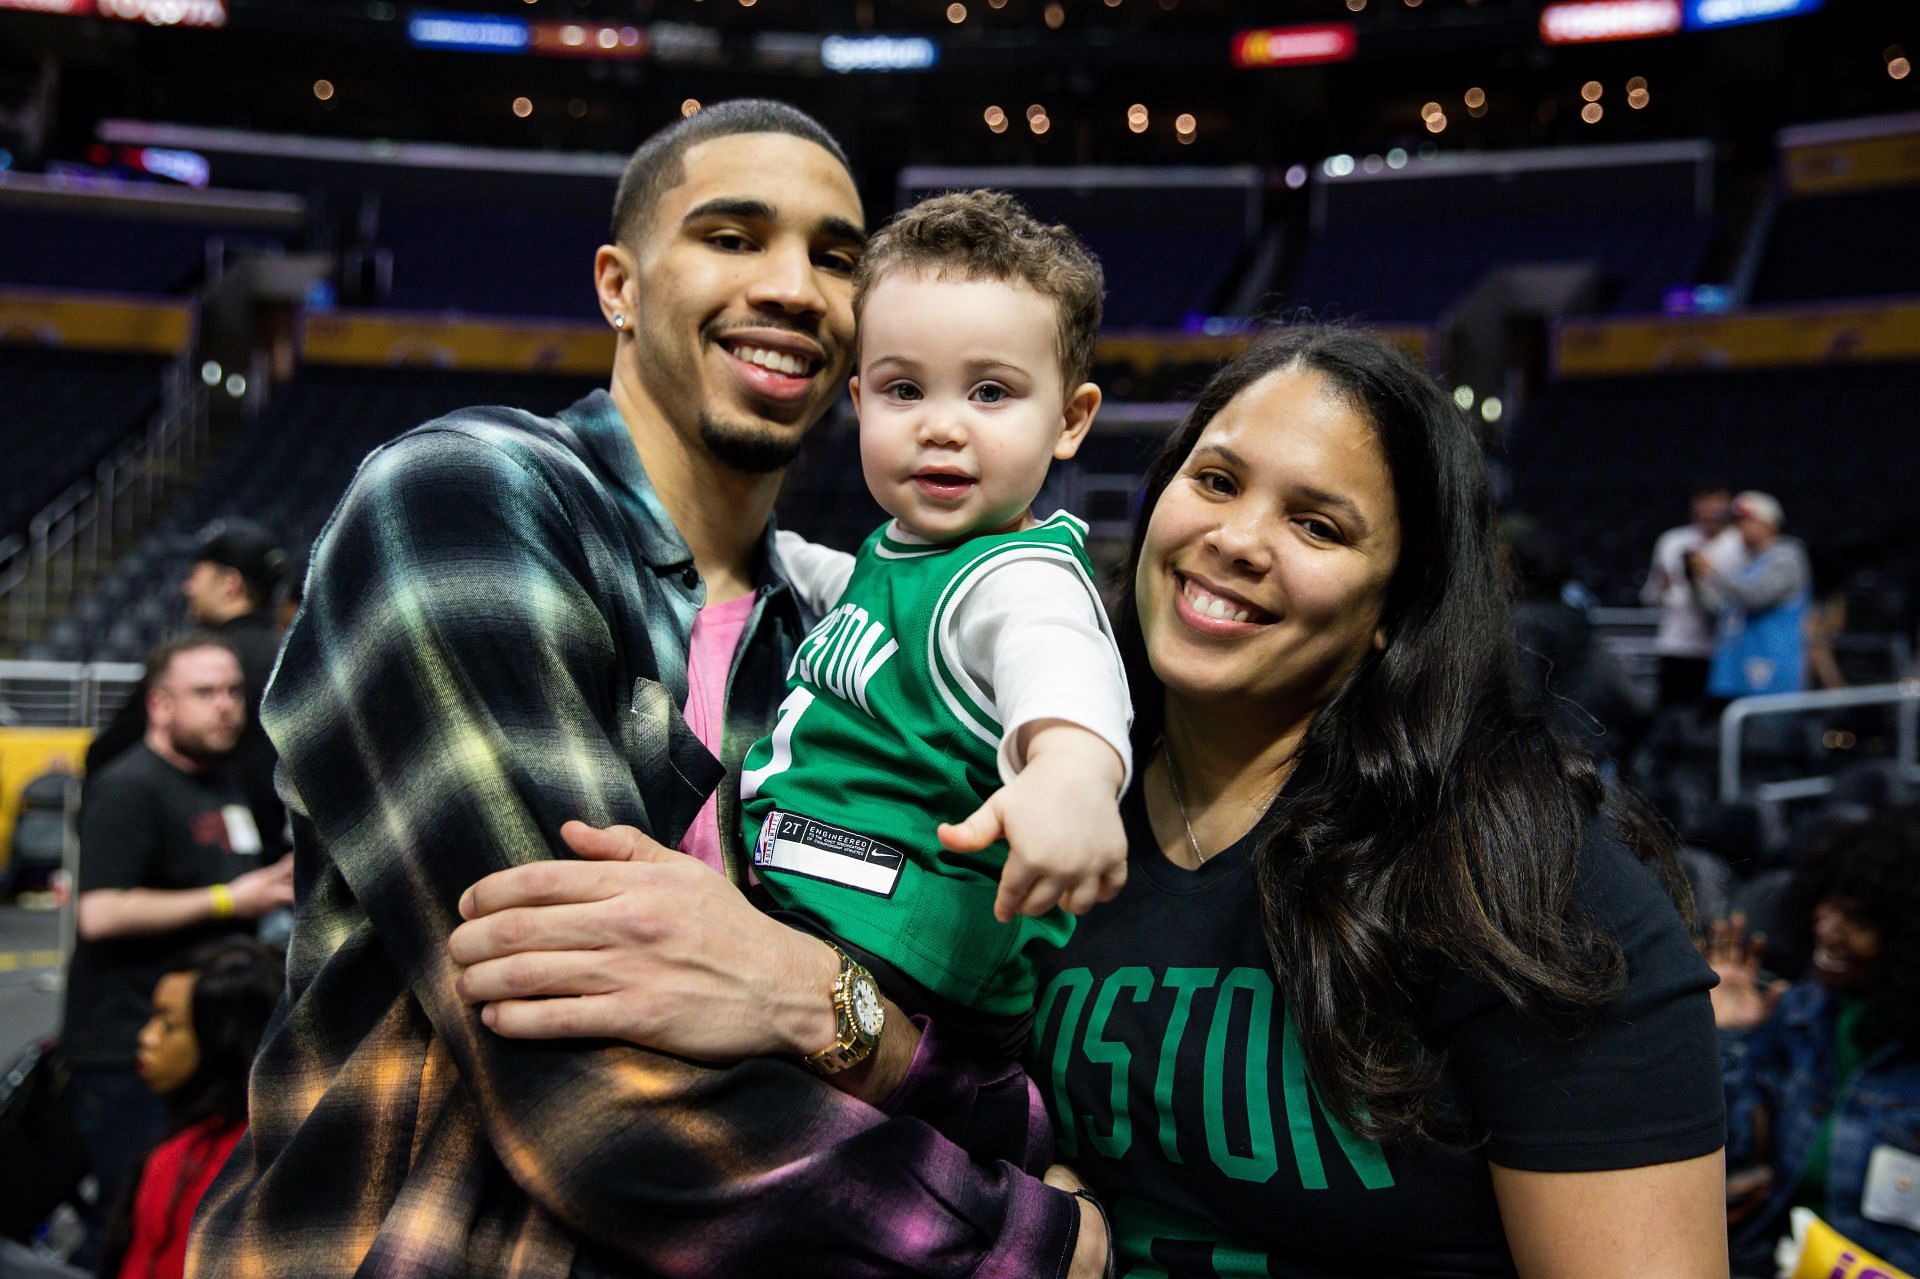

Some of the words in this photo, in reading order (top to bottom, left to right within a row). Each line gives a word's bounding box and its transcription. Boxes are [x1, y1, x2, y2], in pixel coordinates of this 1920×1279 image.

[786, 603, 899, 719] OSTON
[782, 821, 802, 836] 2T
[809, 826, 867, 848] ENGINEERED
[1032, 966, 1395, 1190] OSTON
